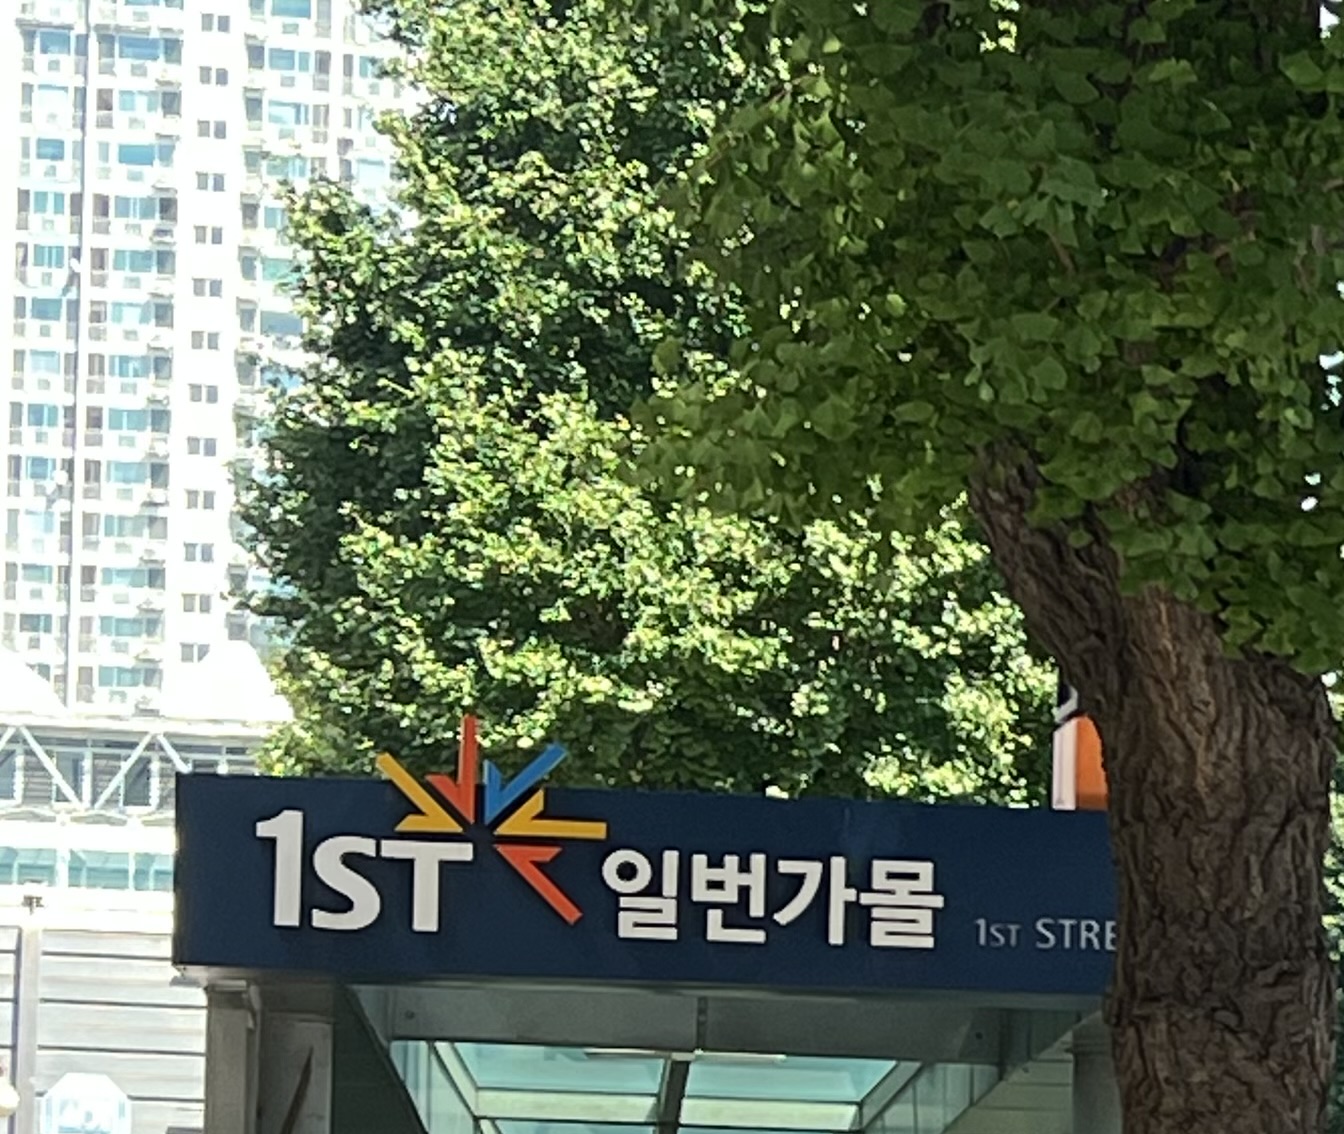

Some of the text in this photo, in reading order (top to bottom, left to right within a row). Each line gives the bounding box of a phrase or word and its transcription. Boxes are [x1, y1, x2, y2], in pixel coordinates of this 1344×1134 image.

[255, 809, 474, 934] 1ST
[602, 848, 945, 949] 일번가몰
[974, 917, 1119, 951] 1ST STRE
